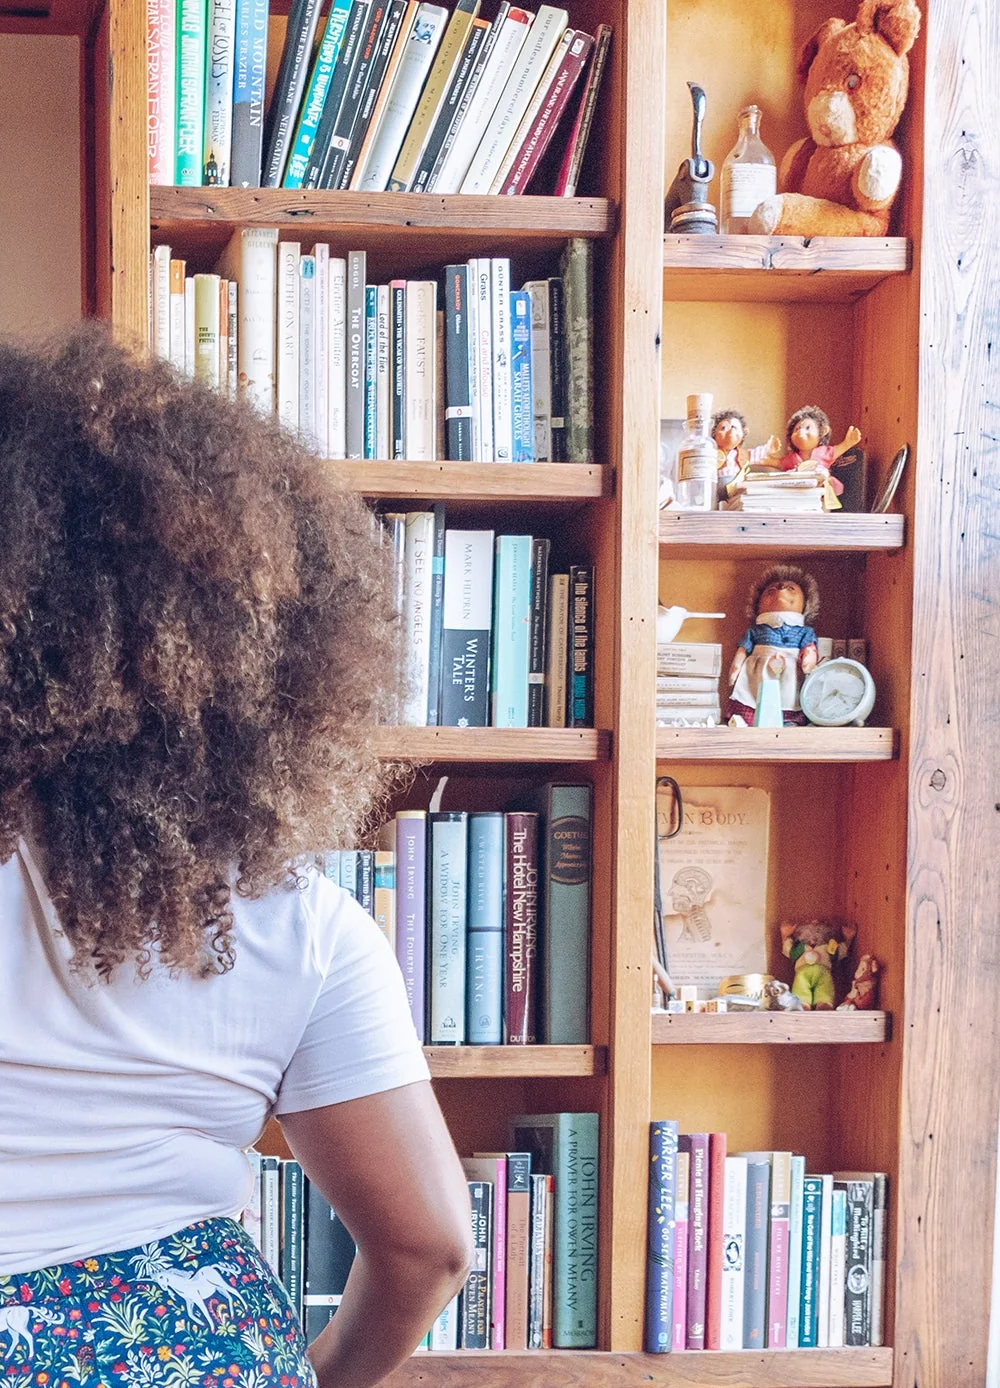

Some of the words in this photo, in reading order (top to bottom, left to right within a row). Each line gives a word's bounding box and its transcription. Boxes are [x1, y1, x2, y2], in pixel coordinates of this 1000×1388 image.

[385, 22, 398, 40] JEAN
[543, 13, 554, 30] our
[467, 28, 482, 55] FIELDING
[528, 31, 546, 66] endless
[238, 39, 249, 89] FRAZIER
[458, 57, 470, 78] JOSEPH
[448, 77, 464, 105] ANDREWS
[506, 67, 531, 114] numbered
[178, 122, 198, 157] FOER
[277, 114, 289, 138] NEIL
[496, 115, 511, 136] days
[268, 139, 284, 179] GAIMAN
[285, 253, 295, 307] GOETHE
[352, 256, 360, 289] GOGOL
[478, 273, 489, 301] Grass
[497, 265, 506, 306] GÜNTER
[285, 310, 296, 329] ON
[351, 307, 361, 329] THE
[285, 335, 294, 360] ART
[480, 329, 489, 346] Cat
[350, 333, 361, 389] OVERCOAT
[481, 347, 490, 365] and
[481, 367, 490, 399] Mouse
[513, 371, 522, 402] SARAH
[513, 404, 522, 440] GRAVES
[415, 551, 424, 574] SEE
[463, 543, 473, 576] MARK
[414, 582, 423, 596] NO
[462, 579, 472, 621] HELPRIN
[574, 582, 588, 595] the
[413, 600, 423, 645] ANGELS
[574, 596, 588, 624] silence
[574, 625, 588, 633] of
[574, 635, 588, 647] the
[451, 654, 465, 685] TALE
[463, 638, 478, 701] WINTER'S
[573, 649, 588, 672] lambs
[406, 835, 416, 861] JOHN
[440, 850, 449, 858] A
[512, 828, 527, 853] The
[406, 865, 416, 899] IRVING
[440, 862, 449, 904] WIDOW
[512, 855, 527, 890] Hotel
[525, 862, 538, 906] JOHN
[451, 879, 461, 910] JOHN
[512, 892, 527, 923] New
[439, 909, 448, 930] FOR
[526, 905, 539, 959] IRVING
[439, 934, 448, 960] ONE
[451, 914, 460, 955] IRVING
[509, 923, 527, 993] Hampshire
[439, 961, 448, 989] YEAR
[474, 946, 485, 1003] IRVING
[567, 1128, 578, 1138] A
[567, 1140, 578, 1186] PRAYER
[660, 1126, 674, 1181] HARPER
[694, 1148, 704, 1177] Picnic
[579, 1154, 596, 1207] JOHN
[694, 1178, 702, 1188] at
[567, 1190, 578, 1215] FOR
[660, 1188, 672, 1210] LEE
[692, 1189, 703, 1227] Hanging
[478, 1213, 487, 1243] JOHN
[517, 1218, 526, 1232] The
[567, 1218, 578, 1258] OWEN
[661, 1227, 670, 1241] GO
[849, 1207, 862, 1259] Mockingbird
[517, 1235, 526, 1267] Portrait
[578, 1214, 596, 1283] IRVING
[660, 1243, 670, 1261] SET
[694, 1228, 702, 1252] Rock
[468, 1273, 478, 1302] OWEN
[477, 1274, 487, 1283] A
[566, 1262, 578, 1311] MEANY
[477, 1286, 486, 1318] PRAYER
[659, 1271, 668, 1323] WATCHMAN
[852, 1299, 864, 1322] HARPER
[440, 1309, 449, 1332] Rules
[467, 1303, 477, 1336] MEANY
[476, 1319, 484, 1336] FOR
[851, 1322, 863, 1334] LEE
